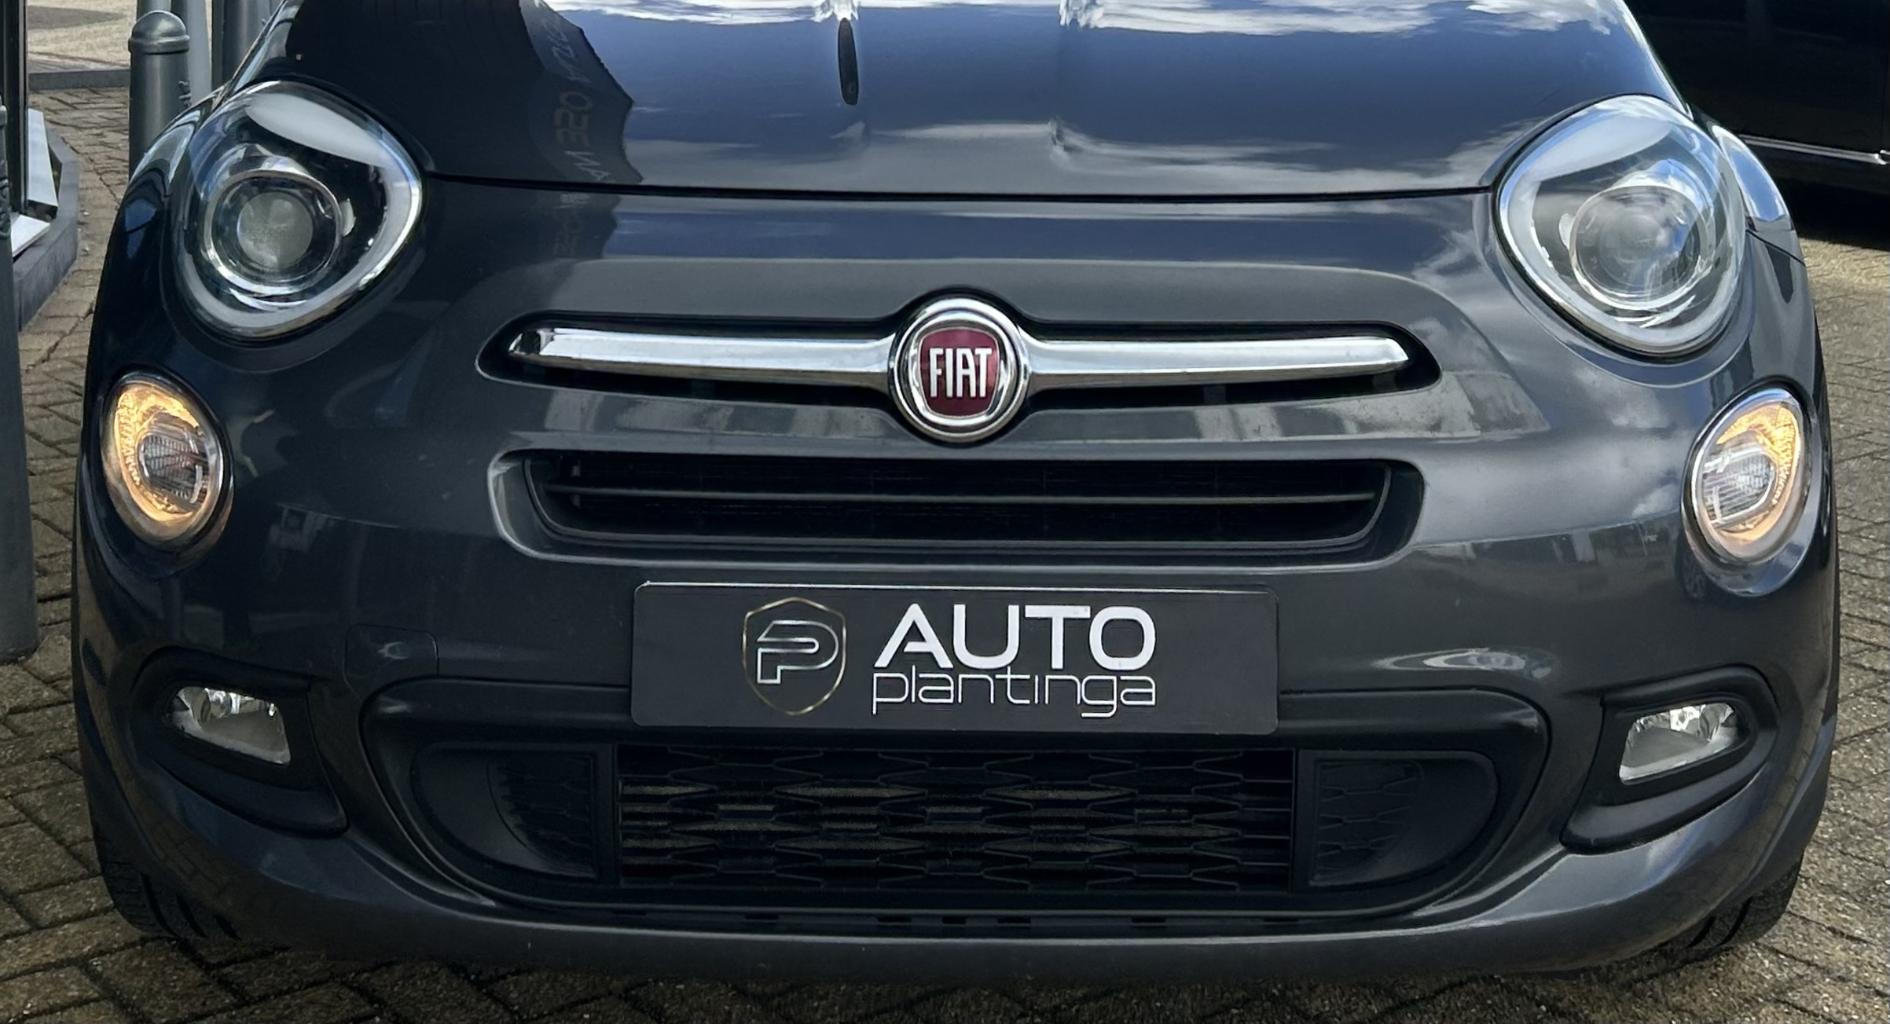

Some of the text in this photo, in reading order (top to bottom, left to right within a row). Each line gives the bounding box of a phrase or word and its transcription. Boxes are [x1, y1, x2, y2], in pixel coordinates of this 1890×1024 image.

[929, 347, 992, 398] FIAT
[873, 603, 1156, 671] AUTO
[872, 665, 1156, 718] plantinga
